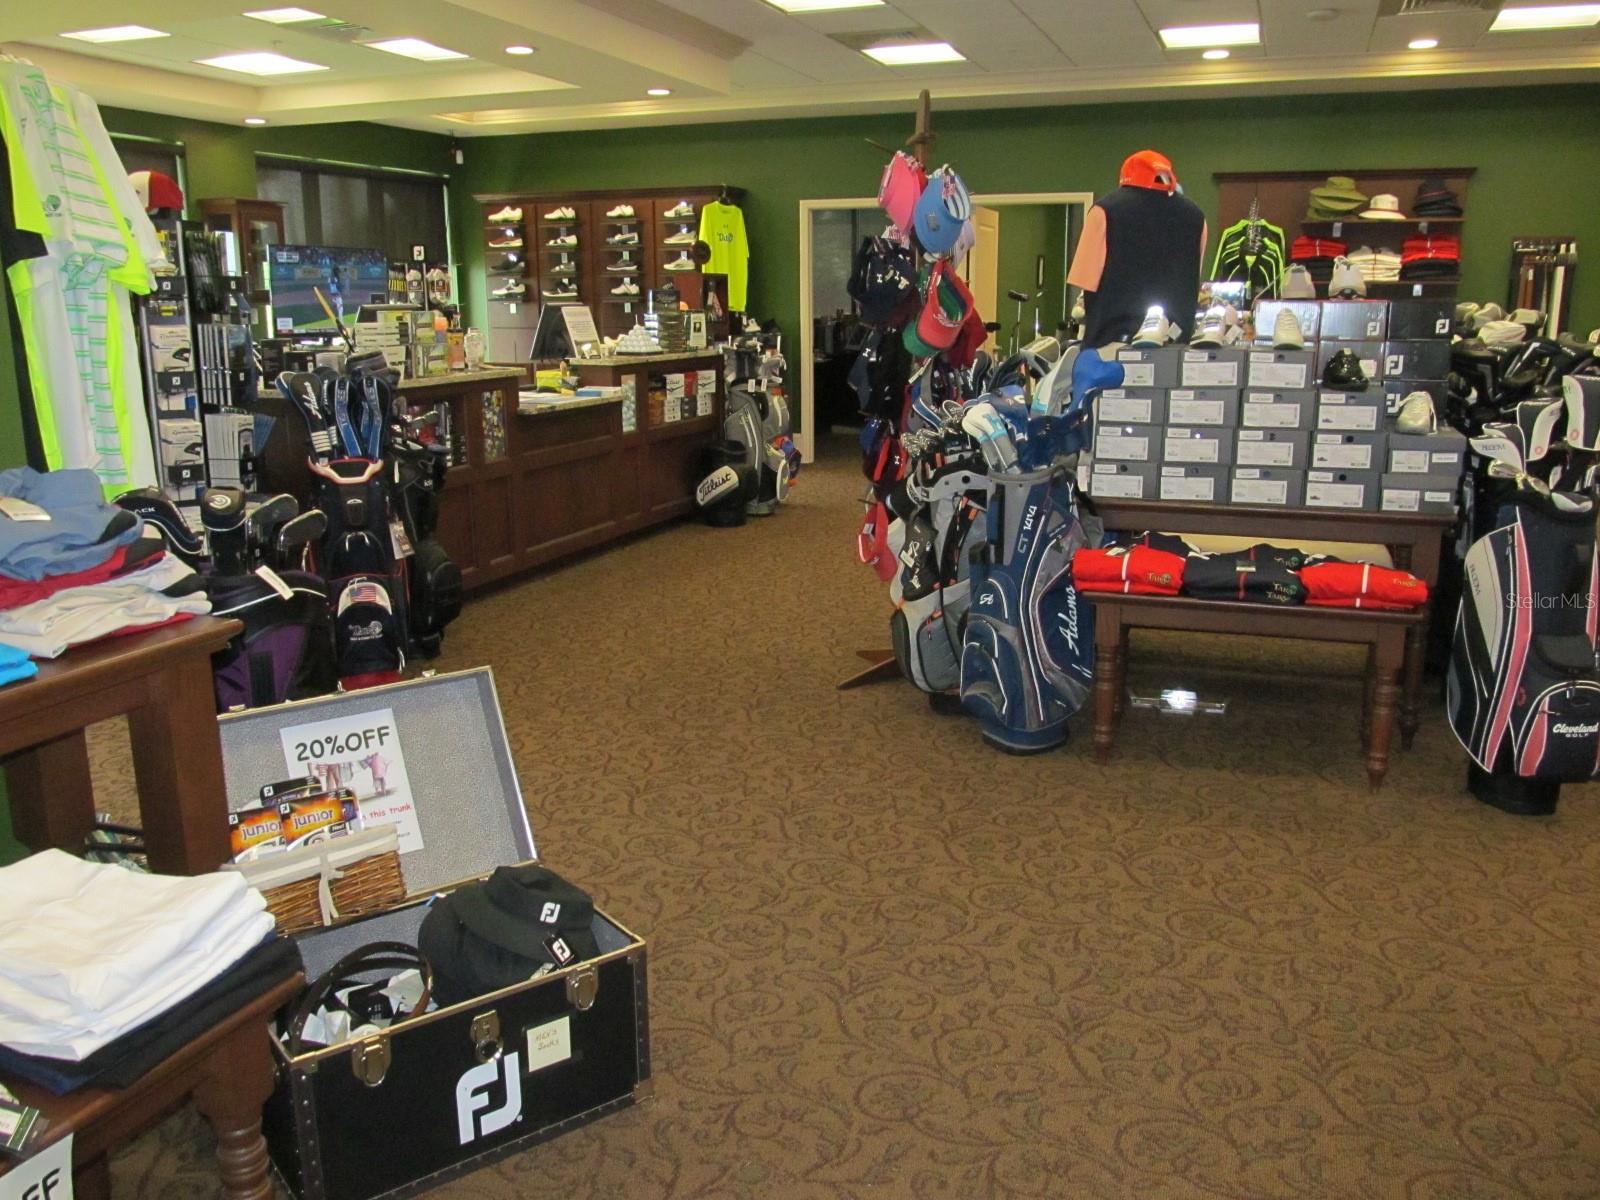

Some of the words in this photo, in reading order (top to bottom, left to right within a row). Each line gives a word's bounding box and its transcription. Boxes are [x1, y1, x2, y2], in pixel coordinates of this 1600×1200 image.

[1366, 321, 1381, 337] FJ
[1434, 318, 1450, 334] FJ
[1384, 354, 1404, 376] FJ
[698, 473, 732, 502] Titleist
[1057, 585, 1080, 656] Adams
[1552, 722, 1599, 734] Cleveland
[294, 725, 391, 762] 20%OFF
[279, 802, 290, 815] FJ
[293, 807, 334, 830] junior
[539, 902, 561, 924] FJ
[552, 937, 572, 960] FJ
[456, 1051, 523, 1145] FJ
